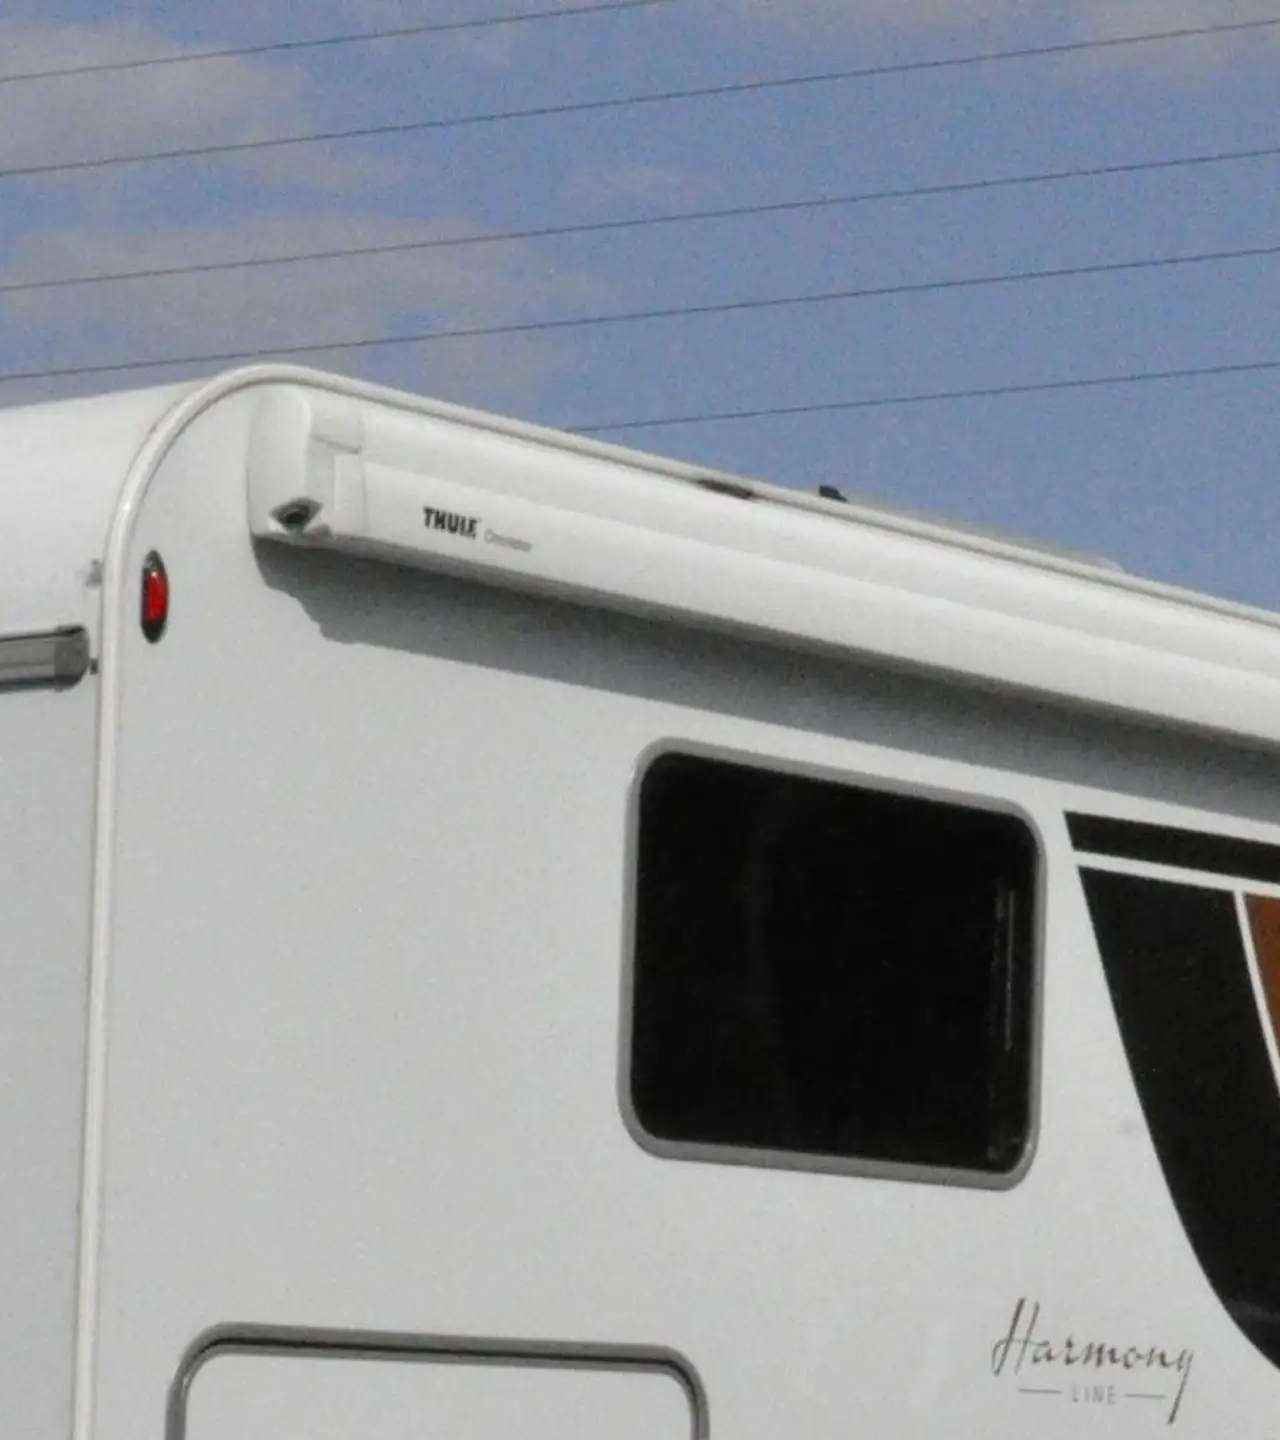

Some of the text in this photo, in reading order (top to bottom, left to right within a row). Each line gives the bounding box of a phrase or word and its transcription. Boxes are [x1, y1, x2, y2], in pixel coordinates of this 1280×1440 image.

[423, 506, 477, 540] THULE
[991, 1297, 1194, 1425] Harmony
[1071, 1385, 1117, 1405] LINE
